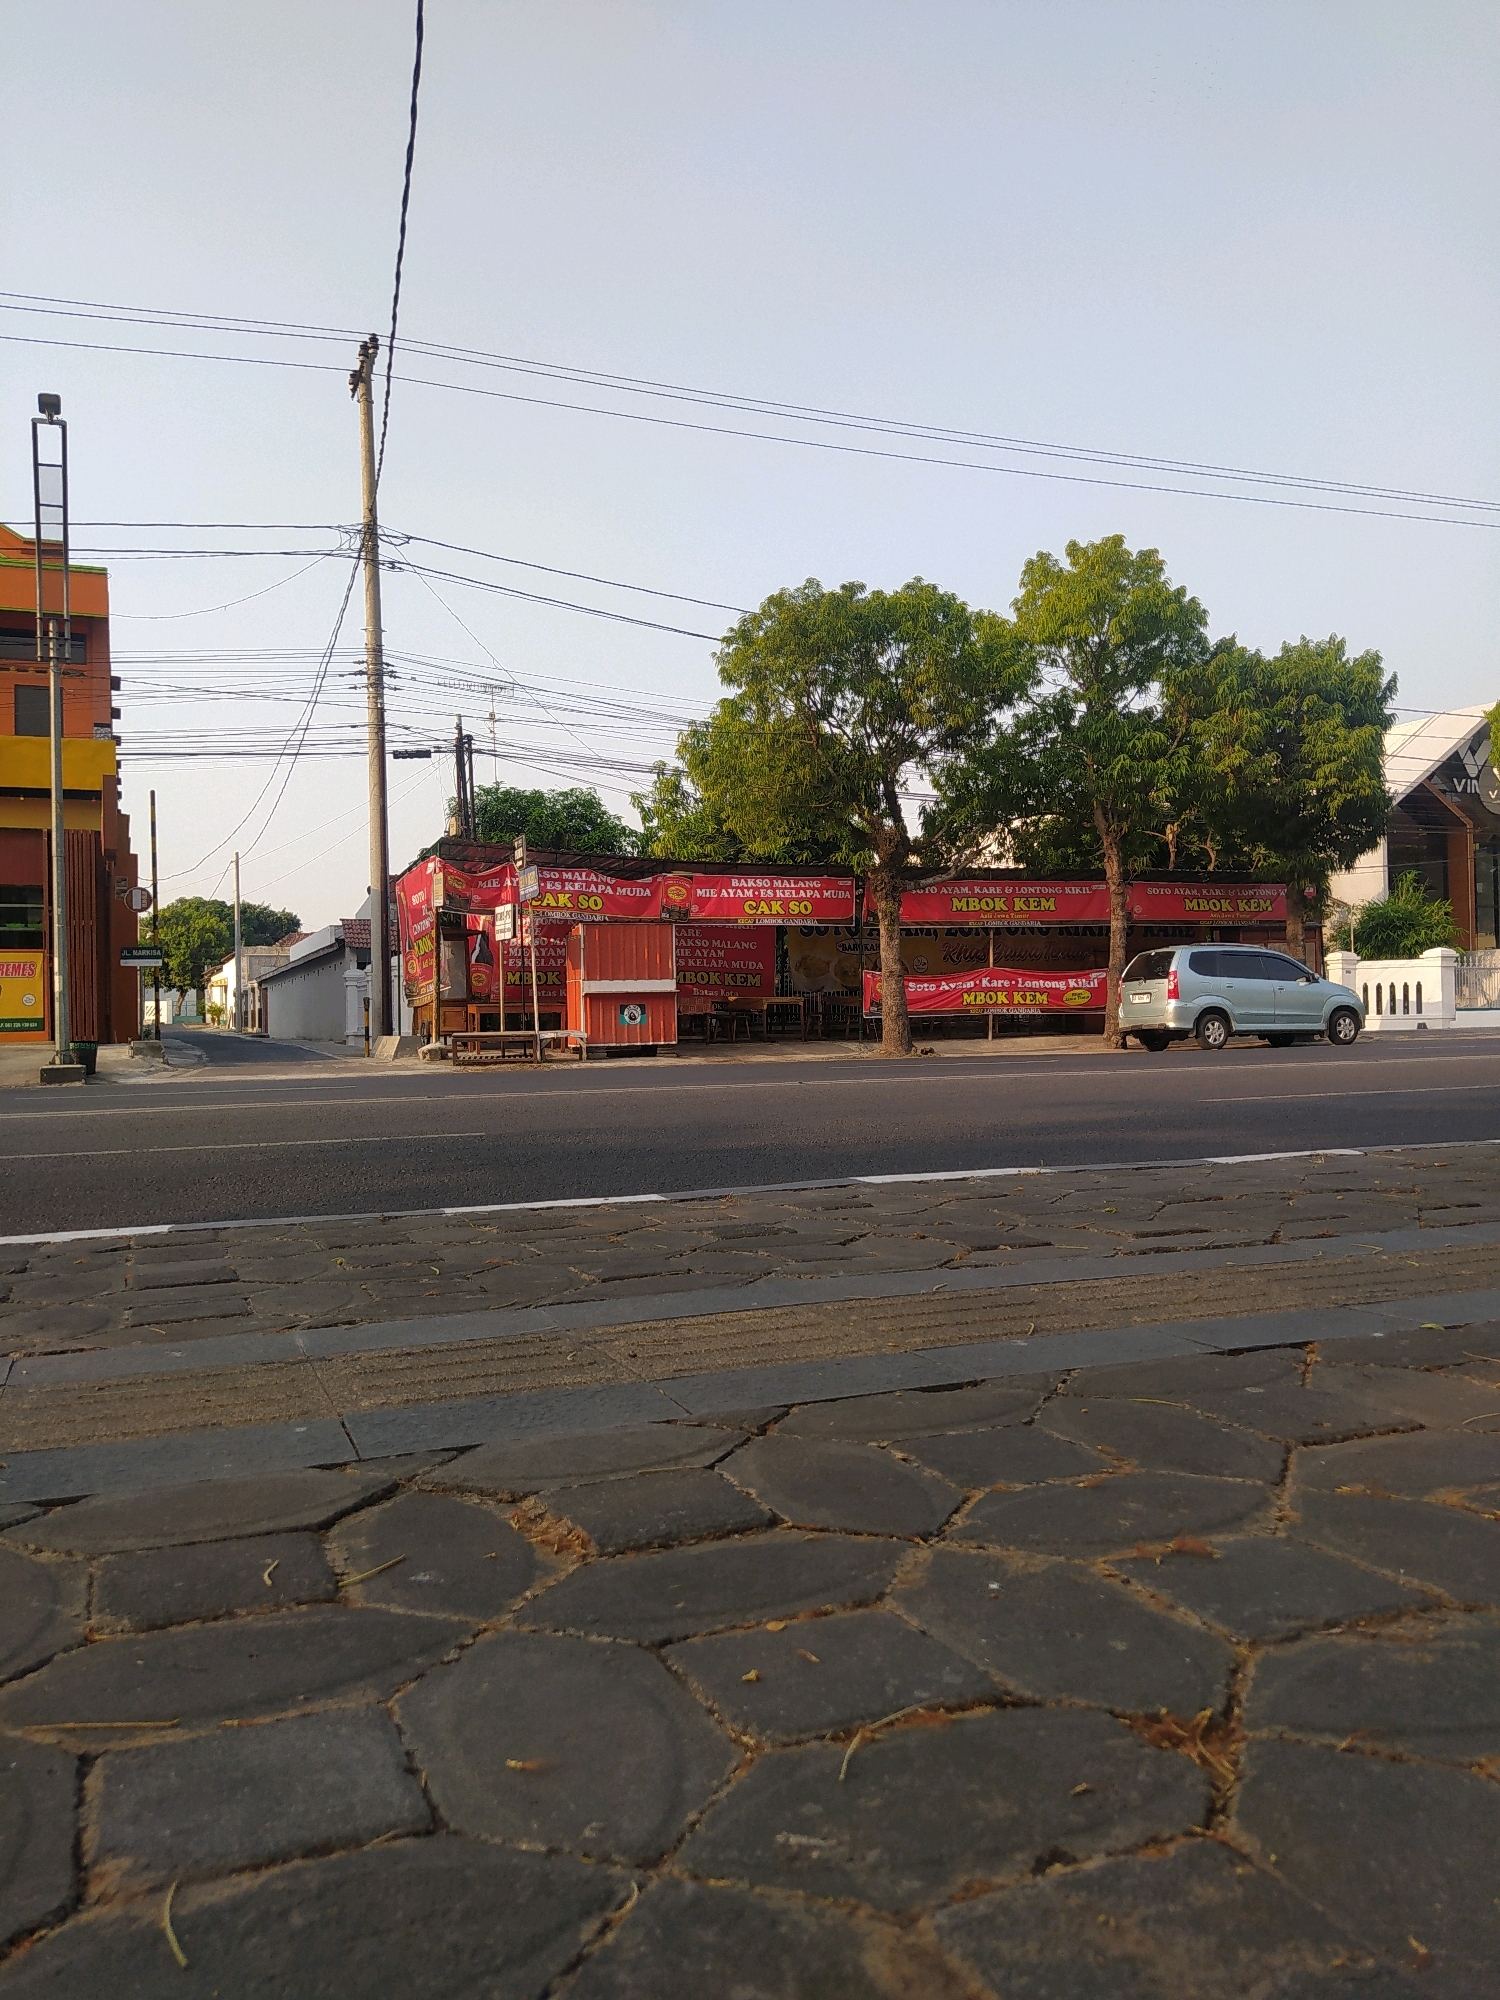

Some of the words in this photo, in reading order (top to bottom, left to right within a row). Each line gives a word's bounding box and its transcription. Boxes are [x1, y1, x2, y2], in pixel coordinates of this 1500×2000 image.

[562, 871, 616, 885] MALANG
[731, 878, 771, 888] BAKSO
[773, 879, 821, 888] MALANG
[477, 878, 501, 889] MIE
[546, 880, 562, 891] ES
[565, 881, 614, 895] KELAPA
[616, 886, 652, 897] MUDA
[696, 888, 718, 898] MIE
[720, 888, 754, 898] AYAM
[760, 889, 774, 898] ES
[776, 889, 821, 899] KELAPA
[823, 890, 851, 899] MUDA
[940, 886, 972, 896] AYAM,
[974, 886, 1002, 894] KARE
[1015, 886, 1063, 894] LONTONG
[1064, 887, 1092, 895] KIKIL
[1147, 887, 1172, 895] SOTO
[1202, 888, 1226, 896] KARE
[1237, 888, 1274, 897] LONTONG
[577, 894, 604, 911] SO
[743, 900, 786, 915] CAK
[788, 900, 813, 915] SO
[952, 897, 1009, 911] MBOK
[1012, 897, 1057, 911] KEM
[1183, 898, 1234, 912] MBOK
[1238, 899, 1273, 912] KEM
[540, 911, 571, 919] LOMBOK
[712, 940, 757, 950] MALANG
[132, 949, 161, 957] MARKISA
[694, 949, 725, 958] AYAM
[688, 958, 729, 969] KELAPA
[731, 960, 764, 970] MUDA
[505, 971, 562, 985] MBOK
[724, 972, 762, 987] KEM
[908, 981, 937, 992] Soto
[939, 980, 975, 992] Ayam
[982, 977, 1011, 988] Kare
[1018, 977, 1066, 991] Lontong
[1068, 977, 1099, 988] Kikil
[692, 987, 719, 996] Batas
[720, 988, 739, 997] Kota
[962, 990, 1009, 1005] MBOK
[1012, 991, 1049, 1005] KEM
